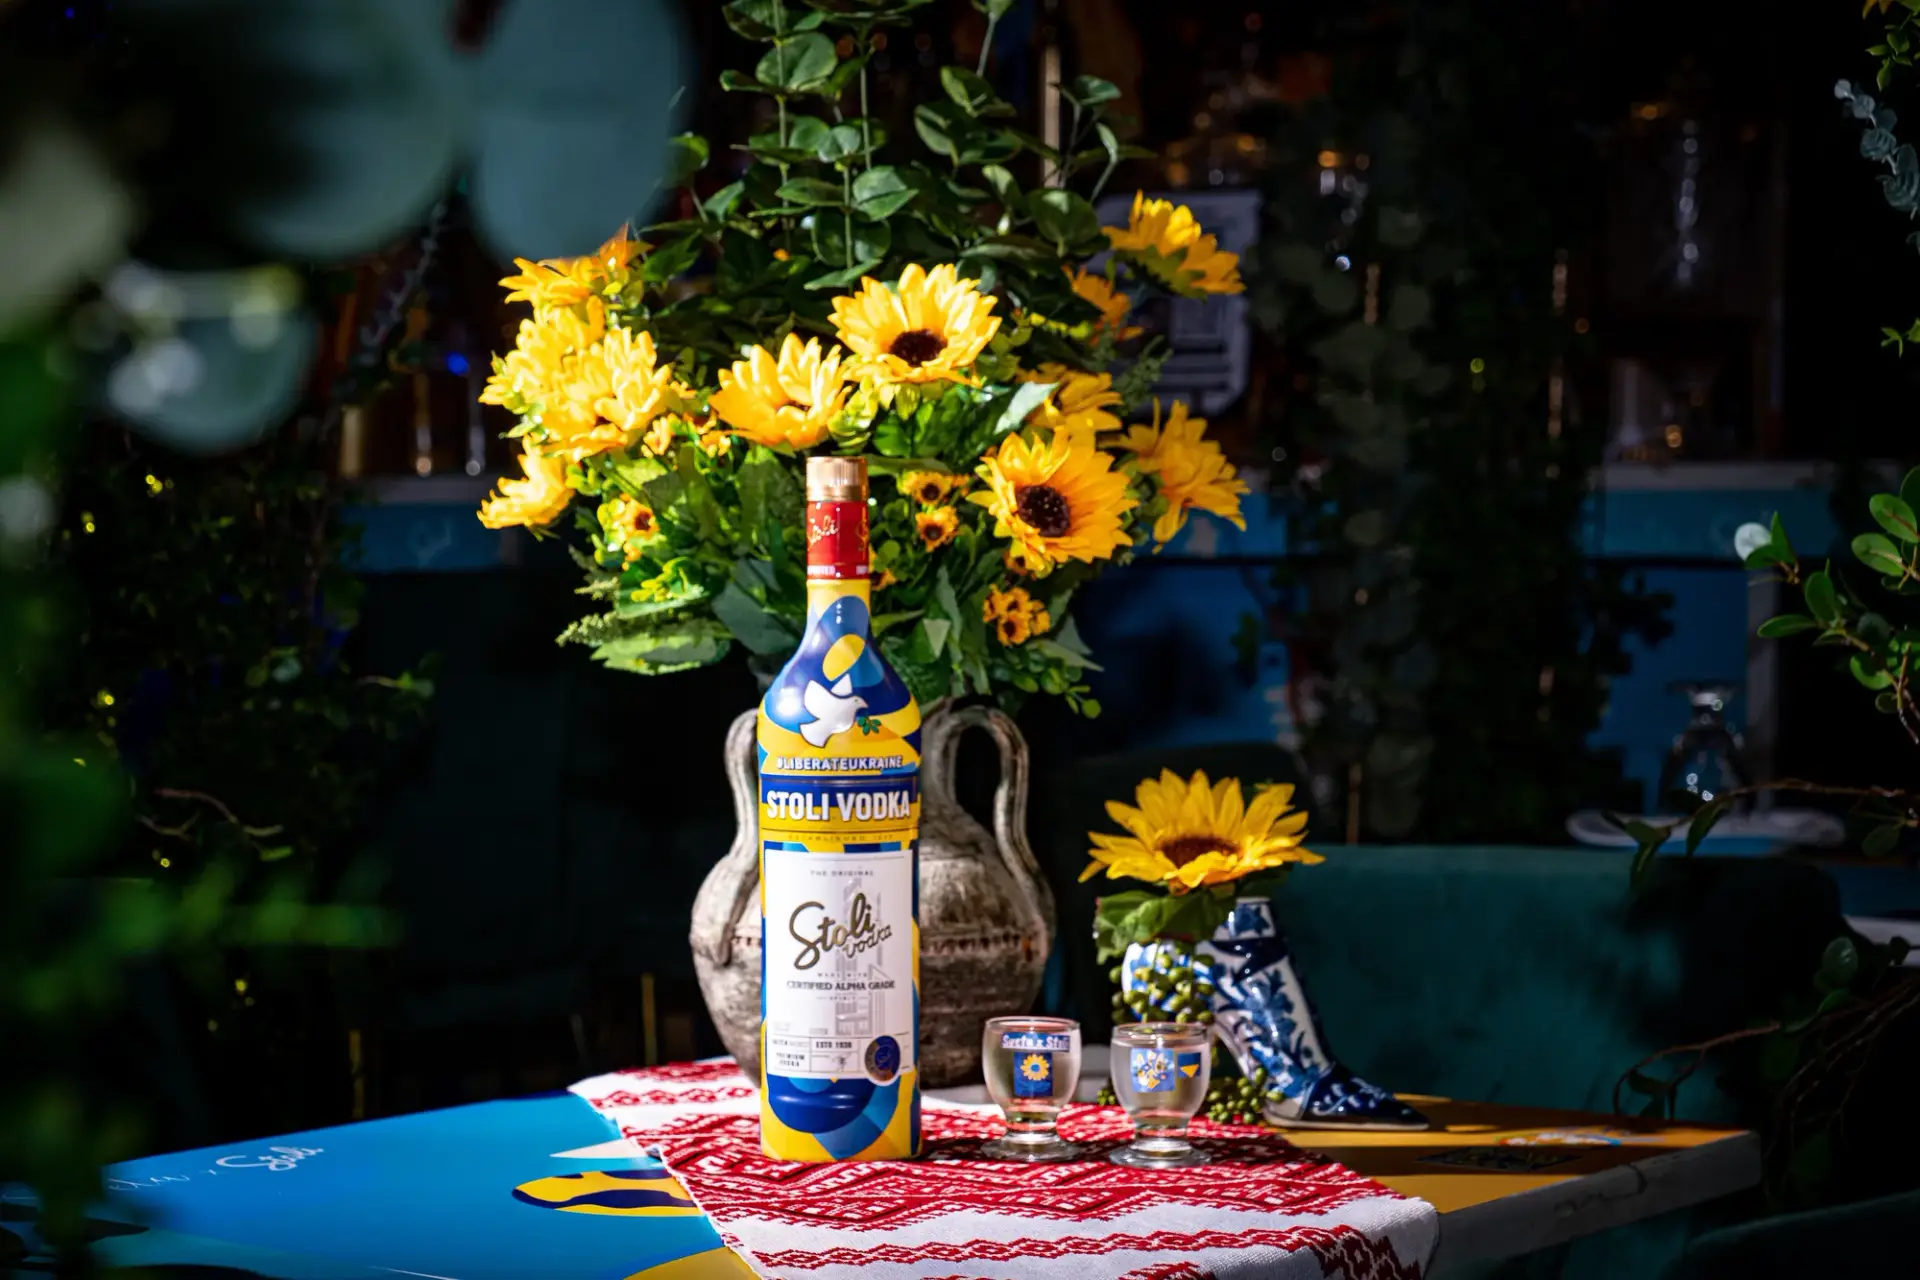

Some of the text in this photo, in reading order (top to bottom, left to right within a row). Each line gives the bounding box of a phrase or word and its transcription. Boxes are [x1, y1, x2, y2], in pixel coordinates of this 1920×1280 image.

[766, 790, 911, 822] STOLI VODKA
[789, 892, 876, 970] Stoli
[842, 924, 893, 959] vodka
[786, 979, 896, 991] CERTIFIED ALPHA GRADE
